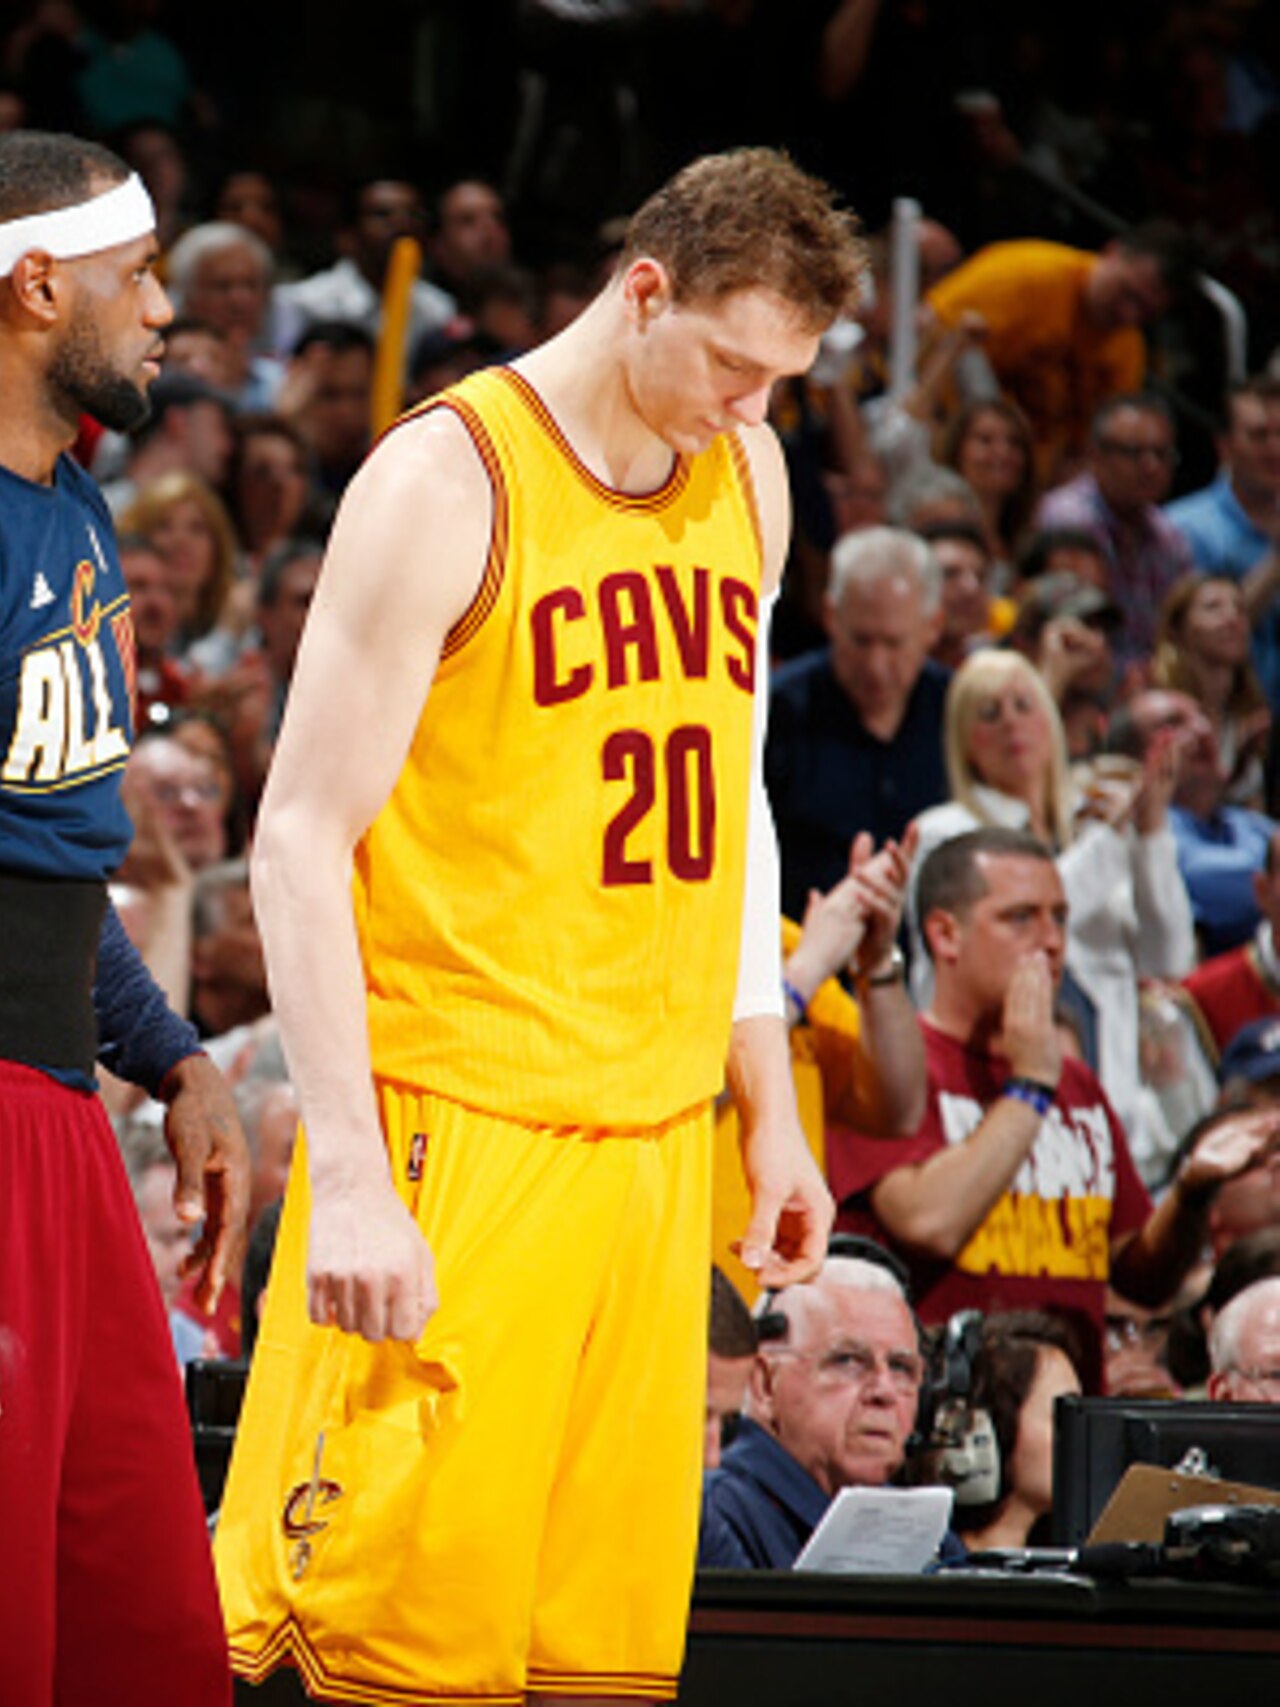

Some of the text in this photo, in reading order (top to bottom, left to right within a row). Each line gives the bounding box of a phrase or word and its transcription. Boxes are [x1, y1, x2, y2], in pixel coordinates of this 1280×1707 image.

[530, 565, 758, 707] CAVS
[0, 640, 130, 782] ALL
[601, 724, 716, 887] 20
